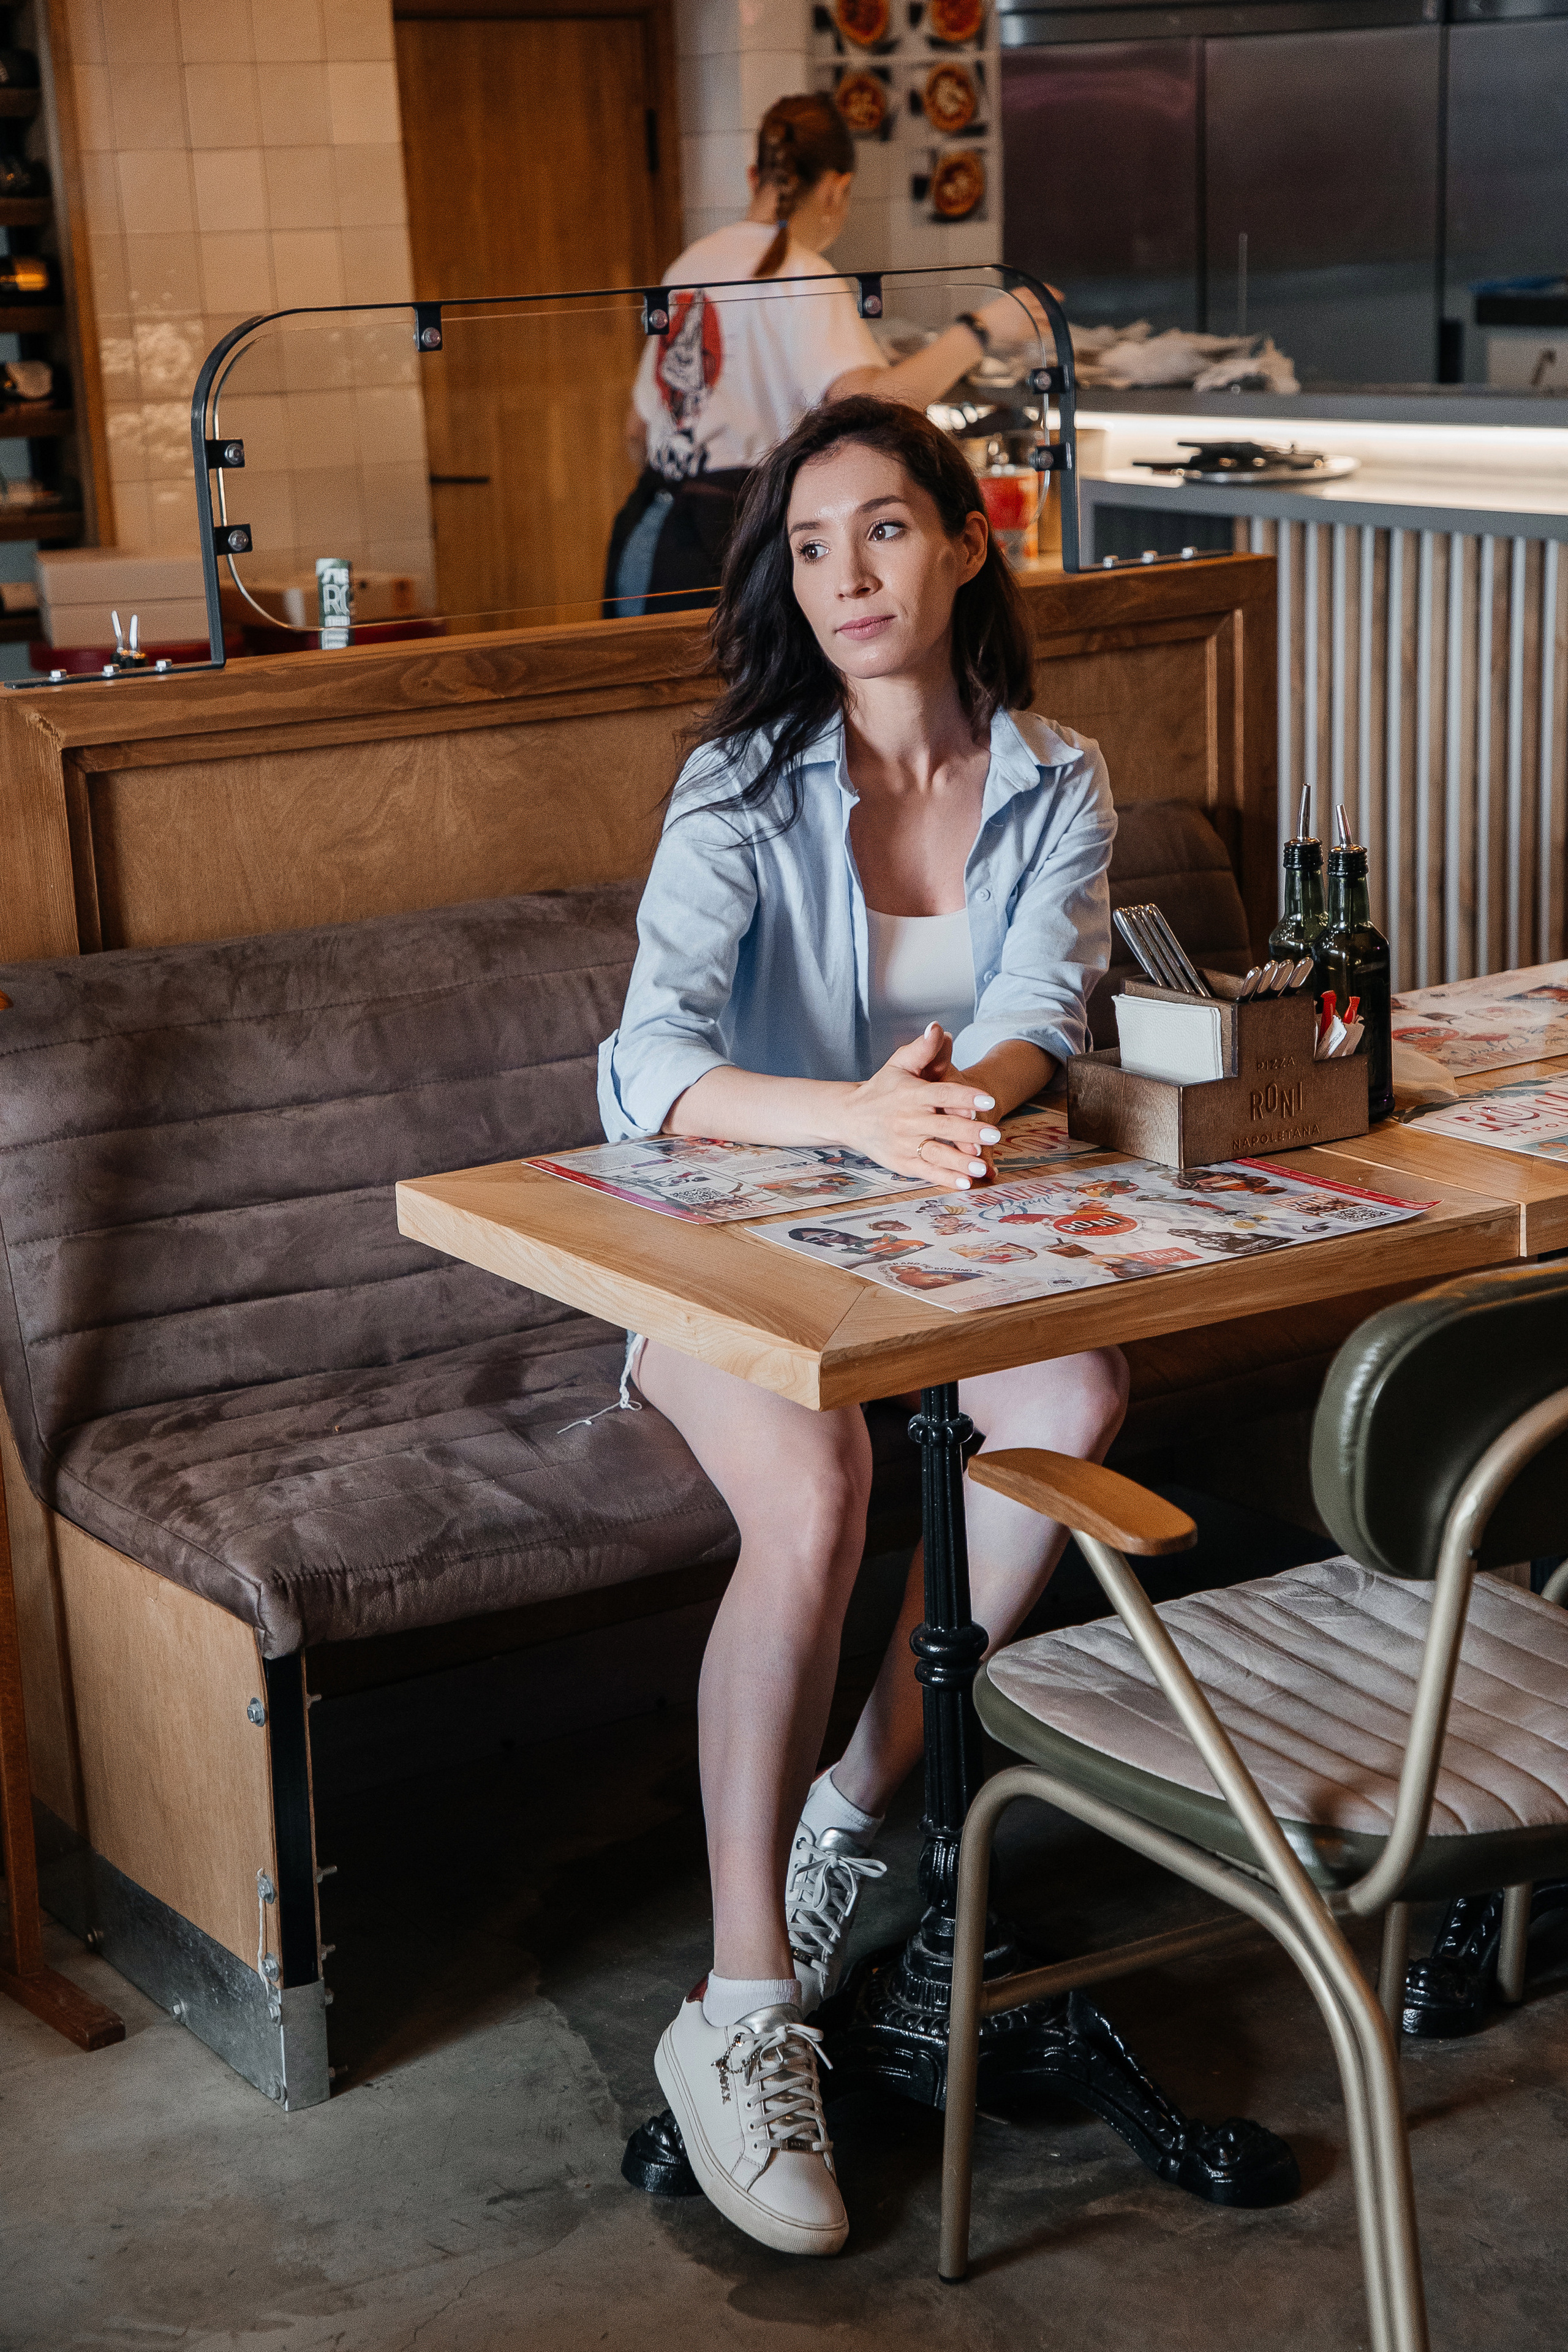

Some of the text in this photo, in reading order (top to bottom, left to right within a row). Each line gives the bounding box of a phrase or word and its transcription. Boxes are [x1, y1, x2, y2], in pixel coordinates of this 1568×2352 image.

[1257, 1056, 1295, 1072] PIZZA
[1251, 1081, 1303, 1120] RONI
[1233, 1124, 1321, 1150] NAPOLETANA
[1058, 1216, 1120, 1232] RONI
[1142, 1250, 1188, 1261] TRUE
